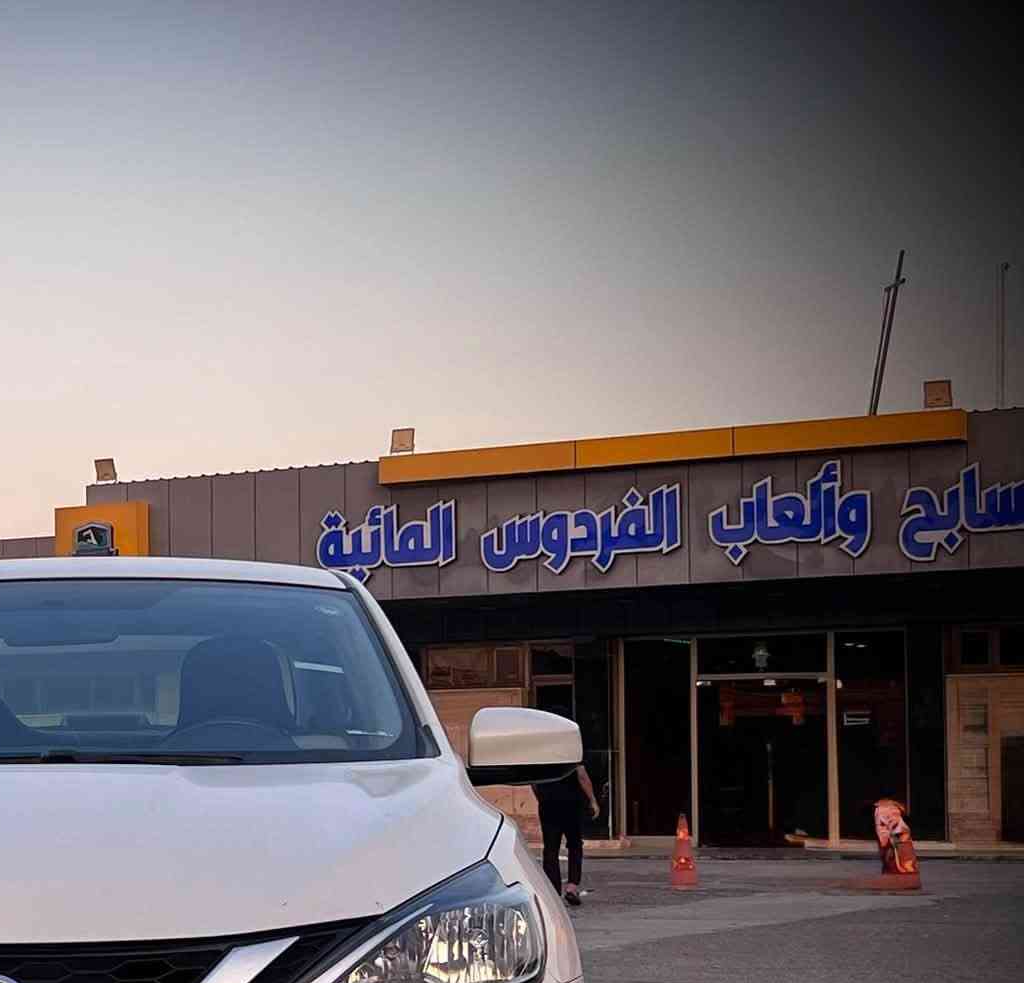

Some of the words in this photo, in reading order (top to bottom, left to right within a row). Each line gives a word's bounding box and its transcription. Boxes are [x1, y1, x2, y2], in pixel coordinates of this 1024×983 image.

[317, 499, 456, 583] المائية
[481, 484, 680, 574] الفردوس
[708, 460, 871, 566] وألعاب
[898, 462, 1024, 561] سابح
